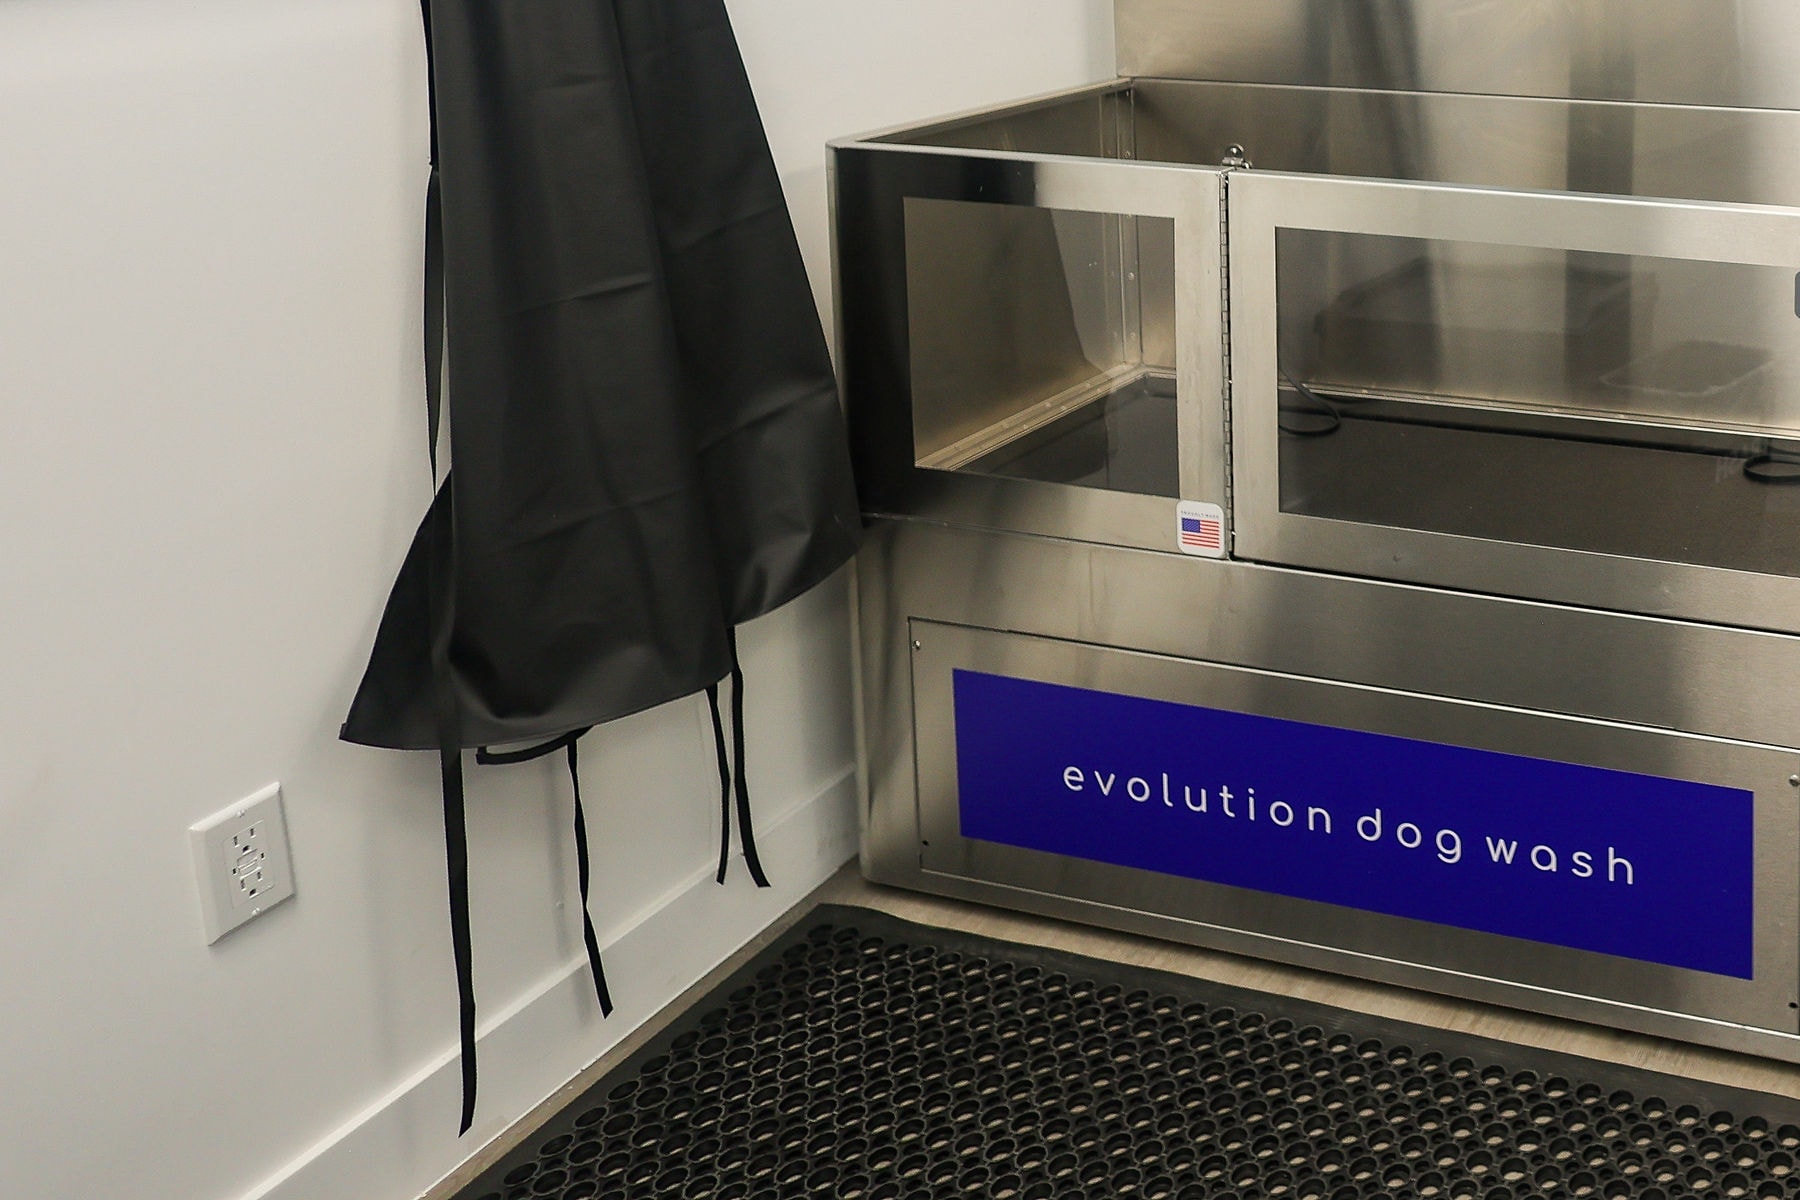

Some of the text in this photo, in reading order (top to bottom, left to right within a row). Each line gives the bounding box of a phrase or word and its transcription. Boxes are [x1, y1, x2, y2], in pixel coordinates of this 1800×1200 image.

[1063, 763, 1634, 886] evolution dog wash
